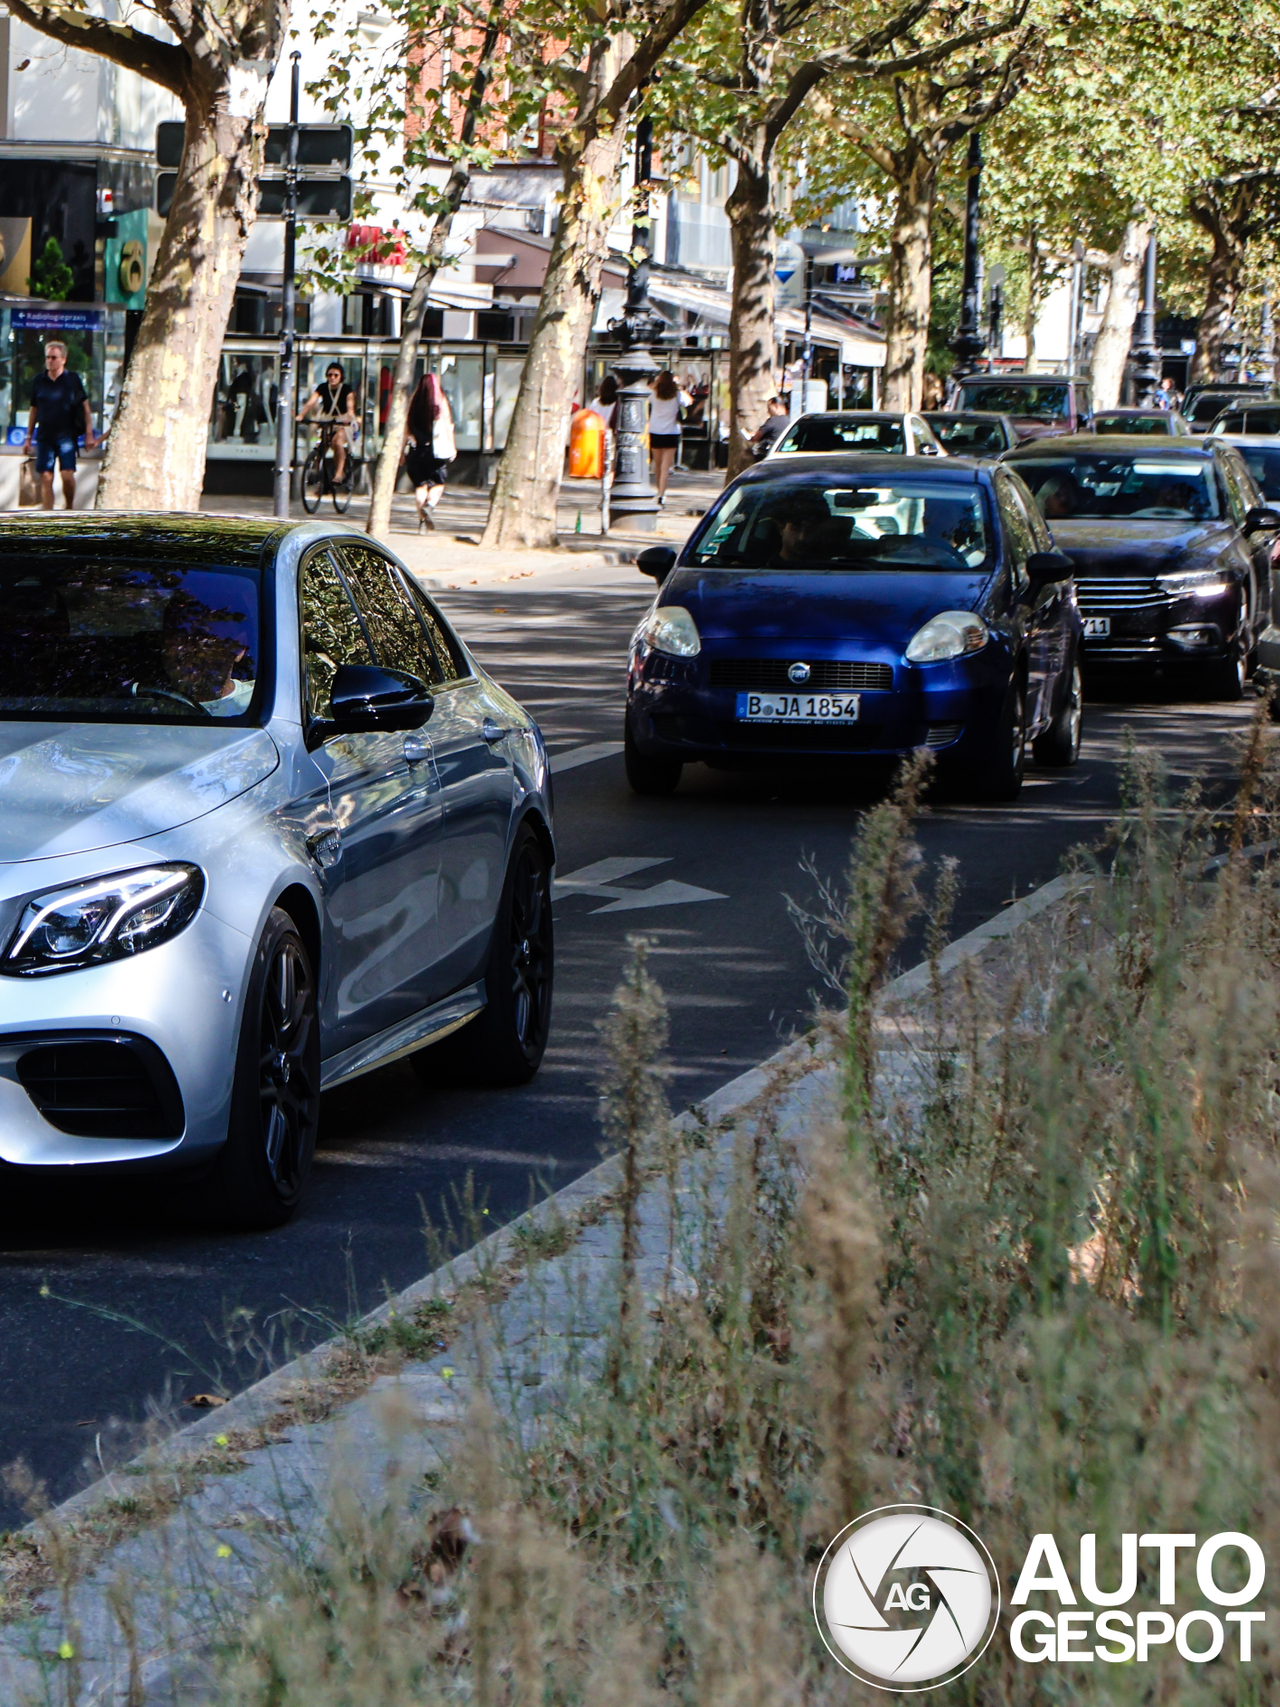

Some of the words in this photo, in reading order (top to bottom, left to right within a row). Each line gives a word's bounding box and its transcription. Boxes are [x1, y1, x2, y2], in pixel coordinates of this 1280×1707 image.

[26, 313, 86, 322] Radiologiepraxis
[791, 670, 807, 678] FIAT
[749, 696, 761, 715] B
[775, 697, 800, 716] JA
[806, 698, 855, 718] 1854
